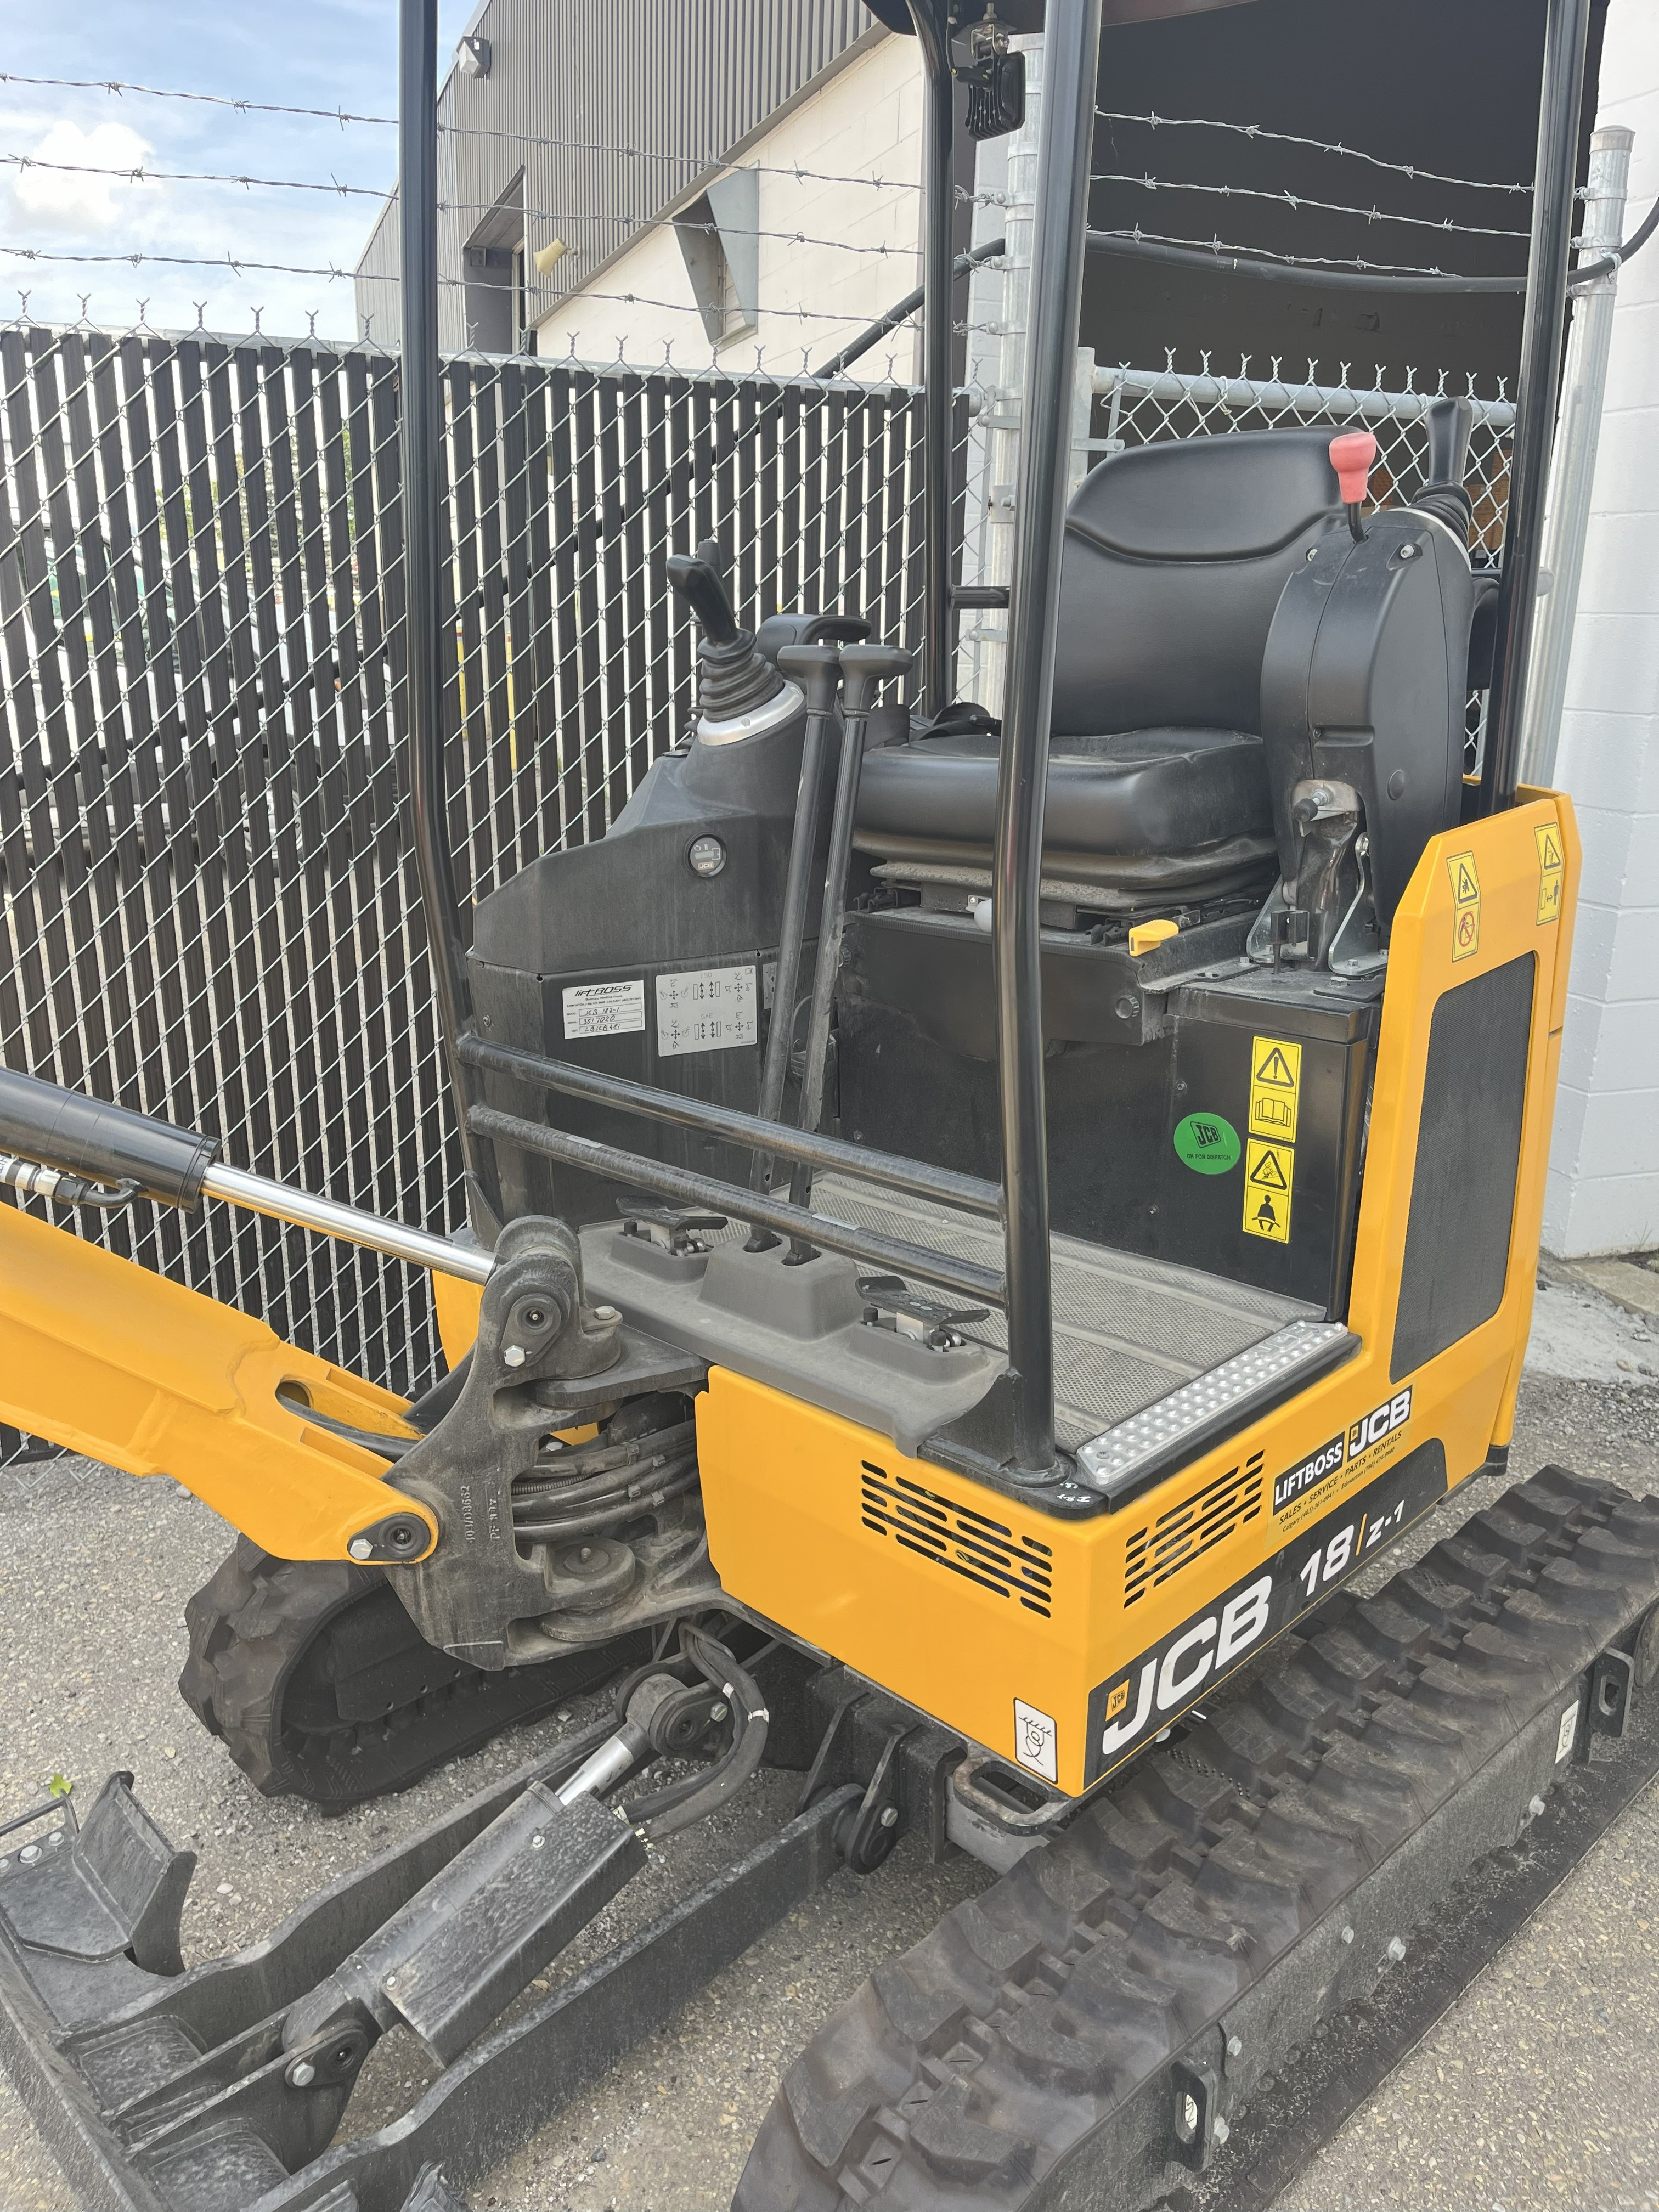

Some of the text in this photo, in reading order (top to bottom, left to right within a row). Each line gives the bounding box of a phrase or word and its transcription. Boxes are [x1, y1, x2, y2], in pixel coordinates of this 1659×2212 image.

[1195, 1124, 1219, 1146] JCB
[1350, 1390, 1410, 1457] JCB
[1274, 1441, 1343, 1506] LIFTBOSS
[1279, 1430, 1402, 1525] SALES SERVICE PARTS RENTALS
[1102, 1575, 1272, 1754] JCB
[1112, 1692, 1124, 1708] JCB
